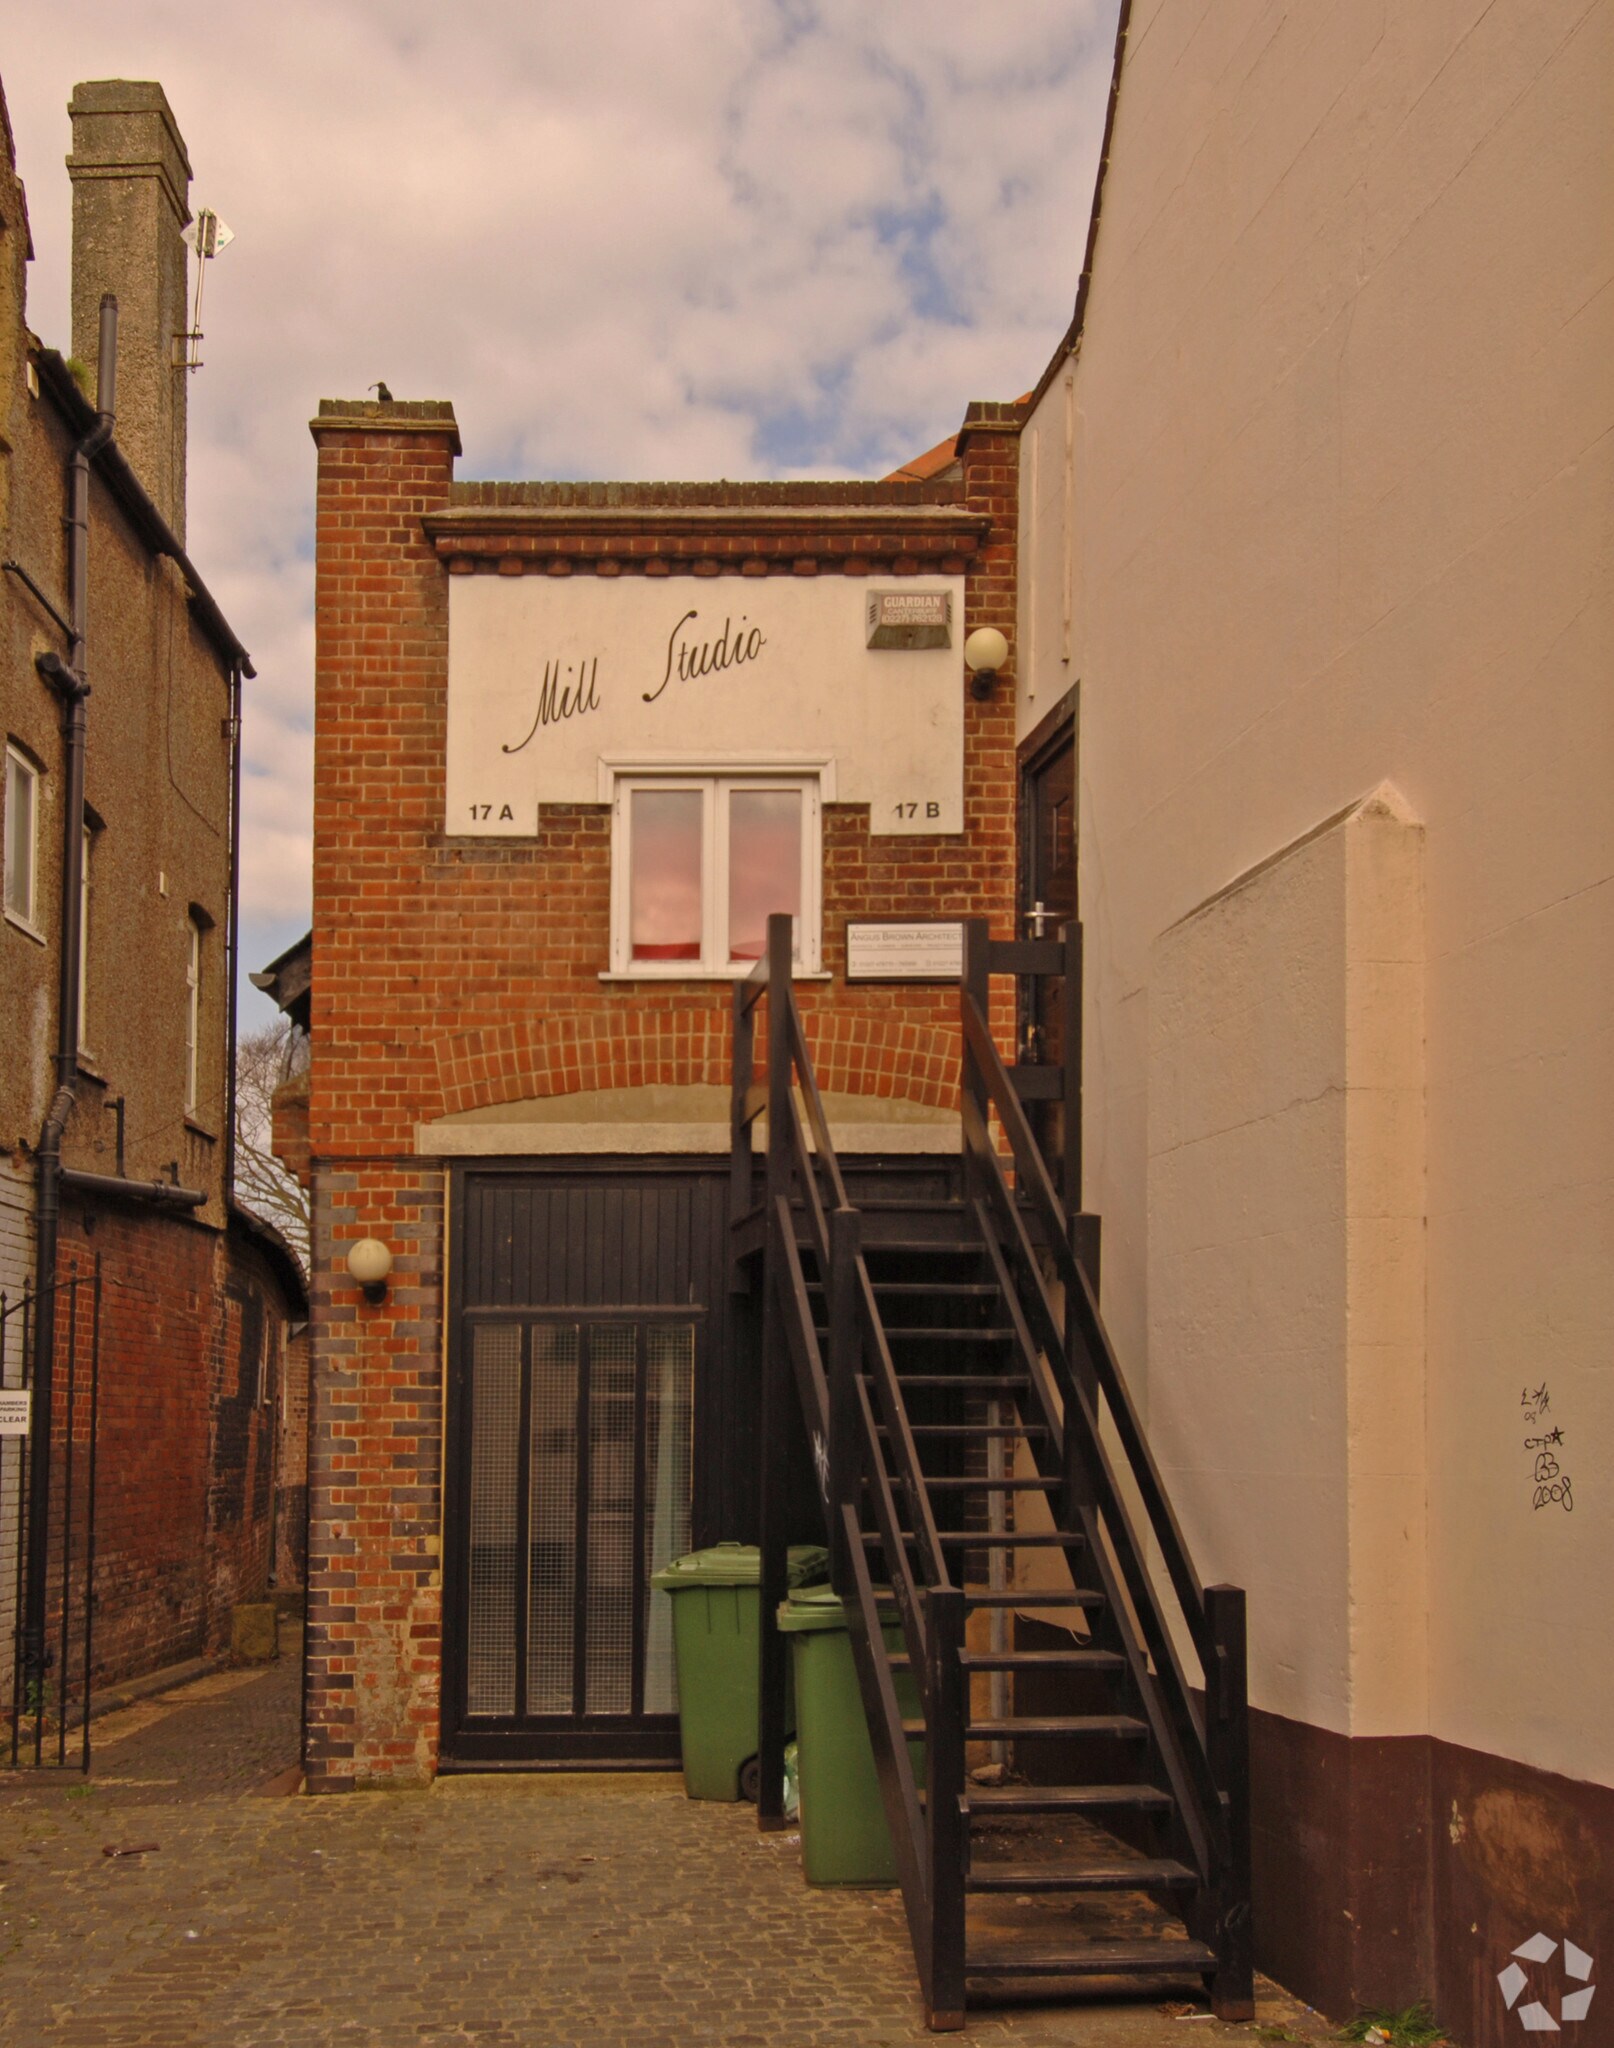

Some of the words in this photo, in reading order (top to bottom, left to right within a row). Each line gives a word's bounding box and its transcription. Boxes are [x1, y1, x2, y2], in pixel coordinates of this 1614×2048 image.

[884, 596, 941, 608] GUARDIAN
[502, 657, 600, 753] Mill
[642, 610, 767, 702] Studio
[469, 804, 492, 820] 17
[499, 804, 514, 820] A
[894, 802, 918, 819] 17
[926, 801, 940, 819] B
